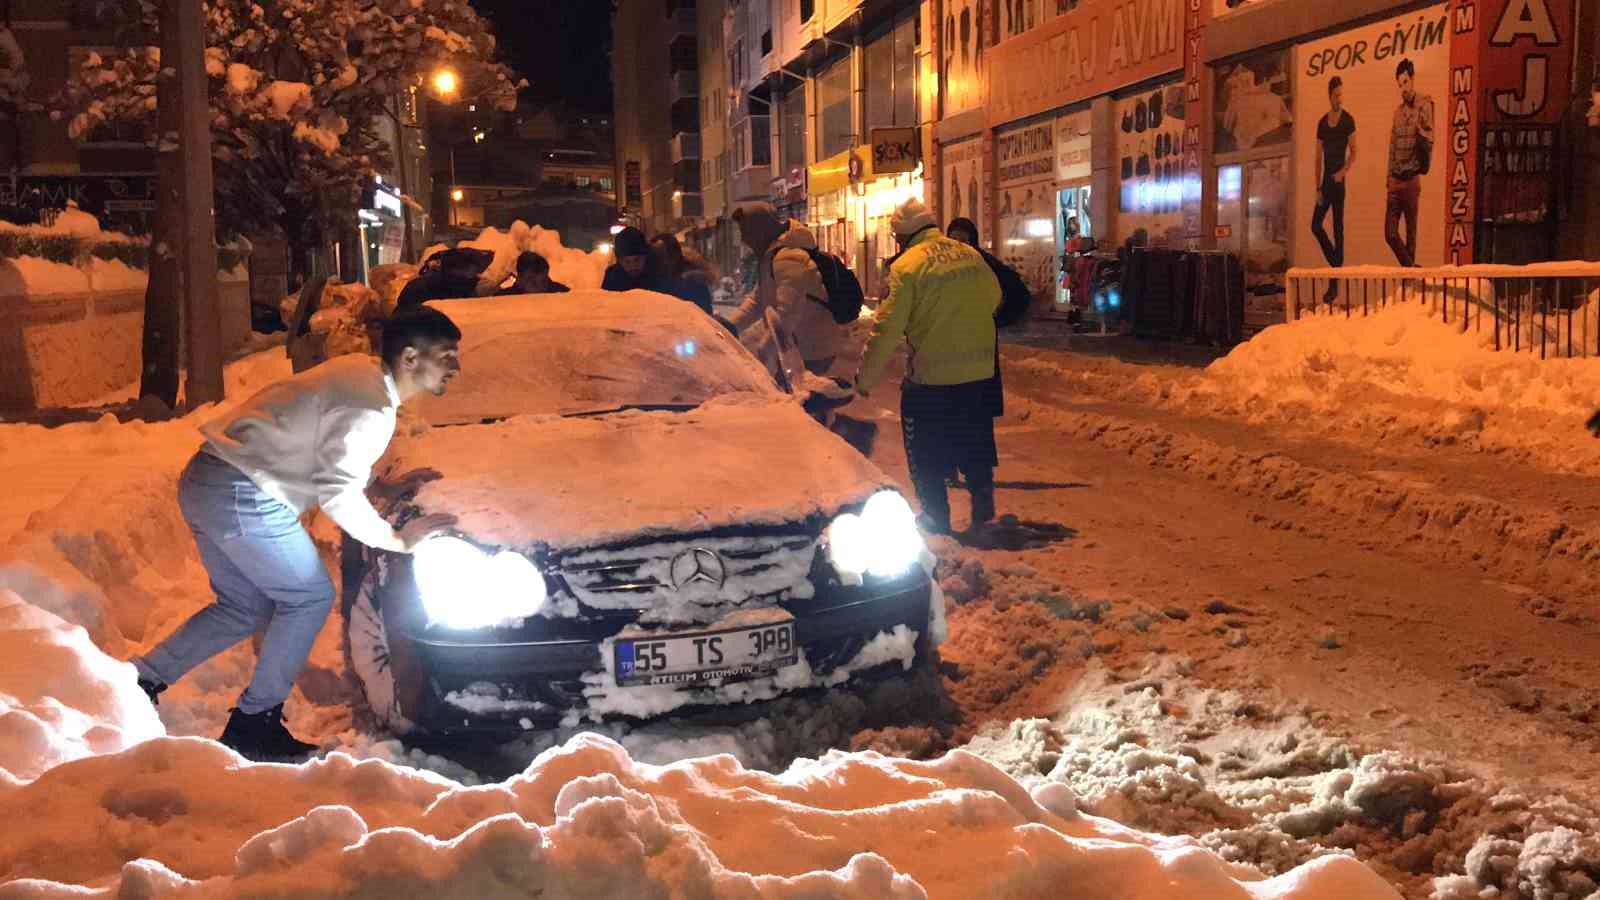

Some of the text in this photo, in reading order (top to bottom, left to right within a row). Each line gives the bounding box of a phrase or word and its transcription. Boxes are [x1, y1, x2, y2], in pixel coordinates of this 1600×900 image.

[1305, 15, 1448, 77] SPOR GİYİM
[634, 642, 667, 672] 55
[692, 636, 724, 666] TS
